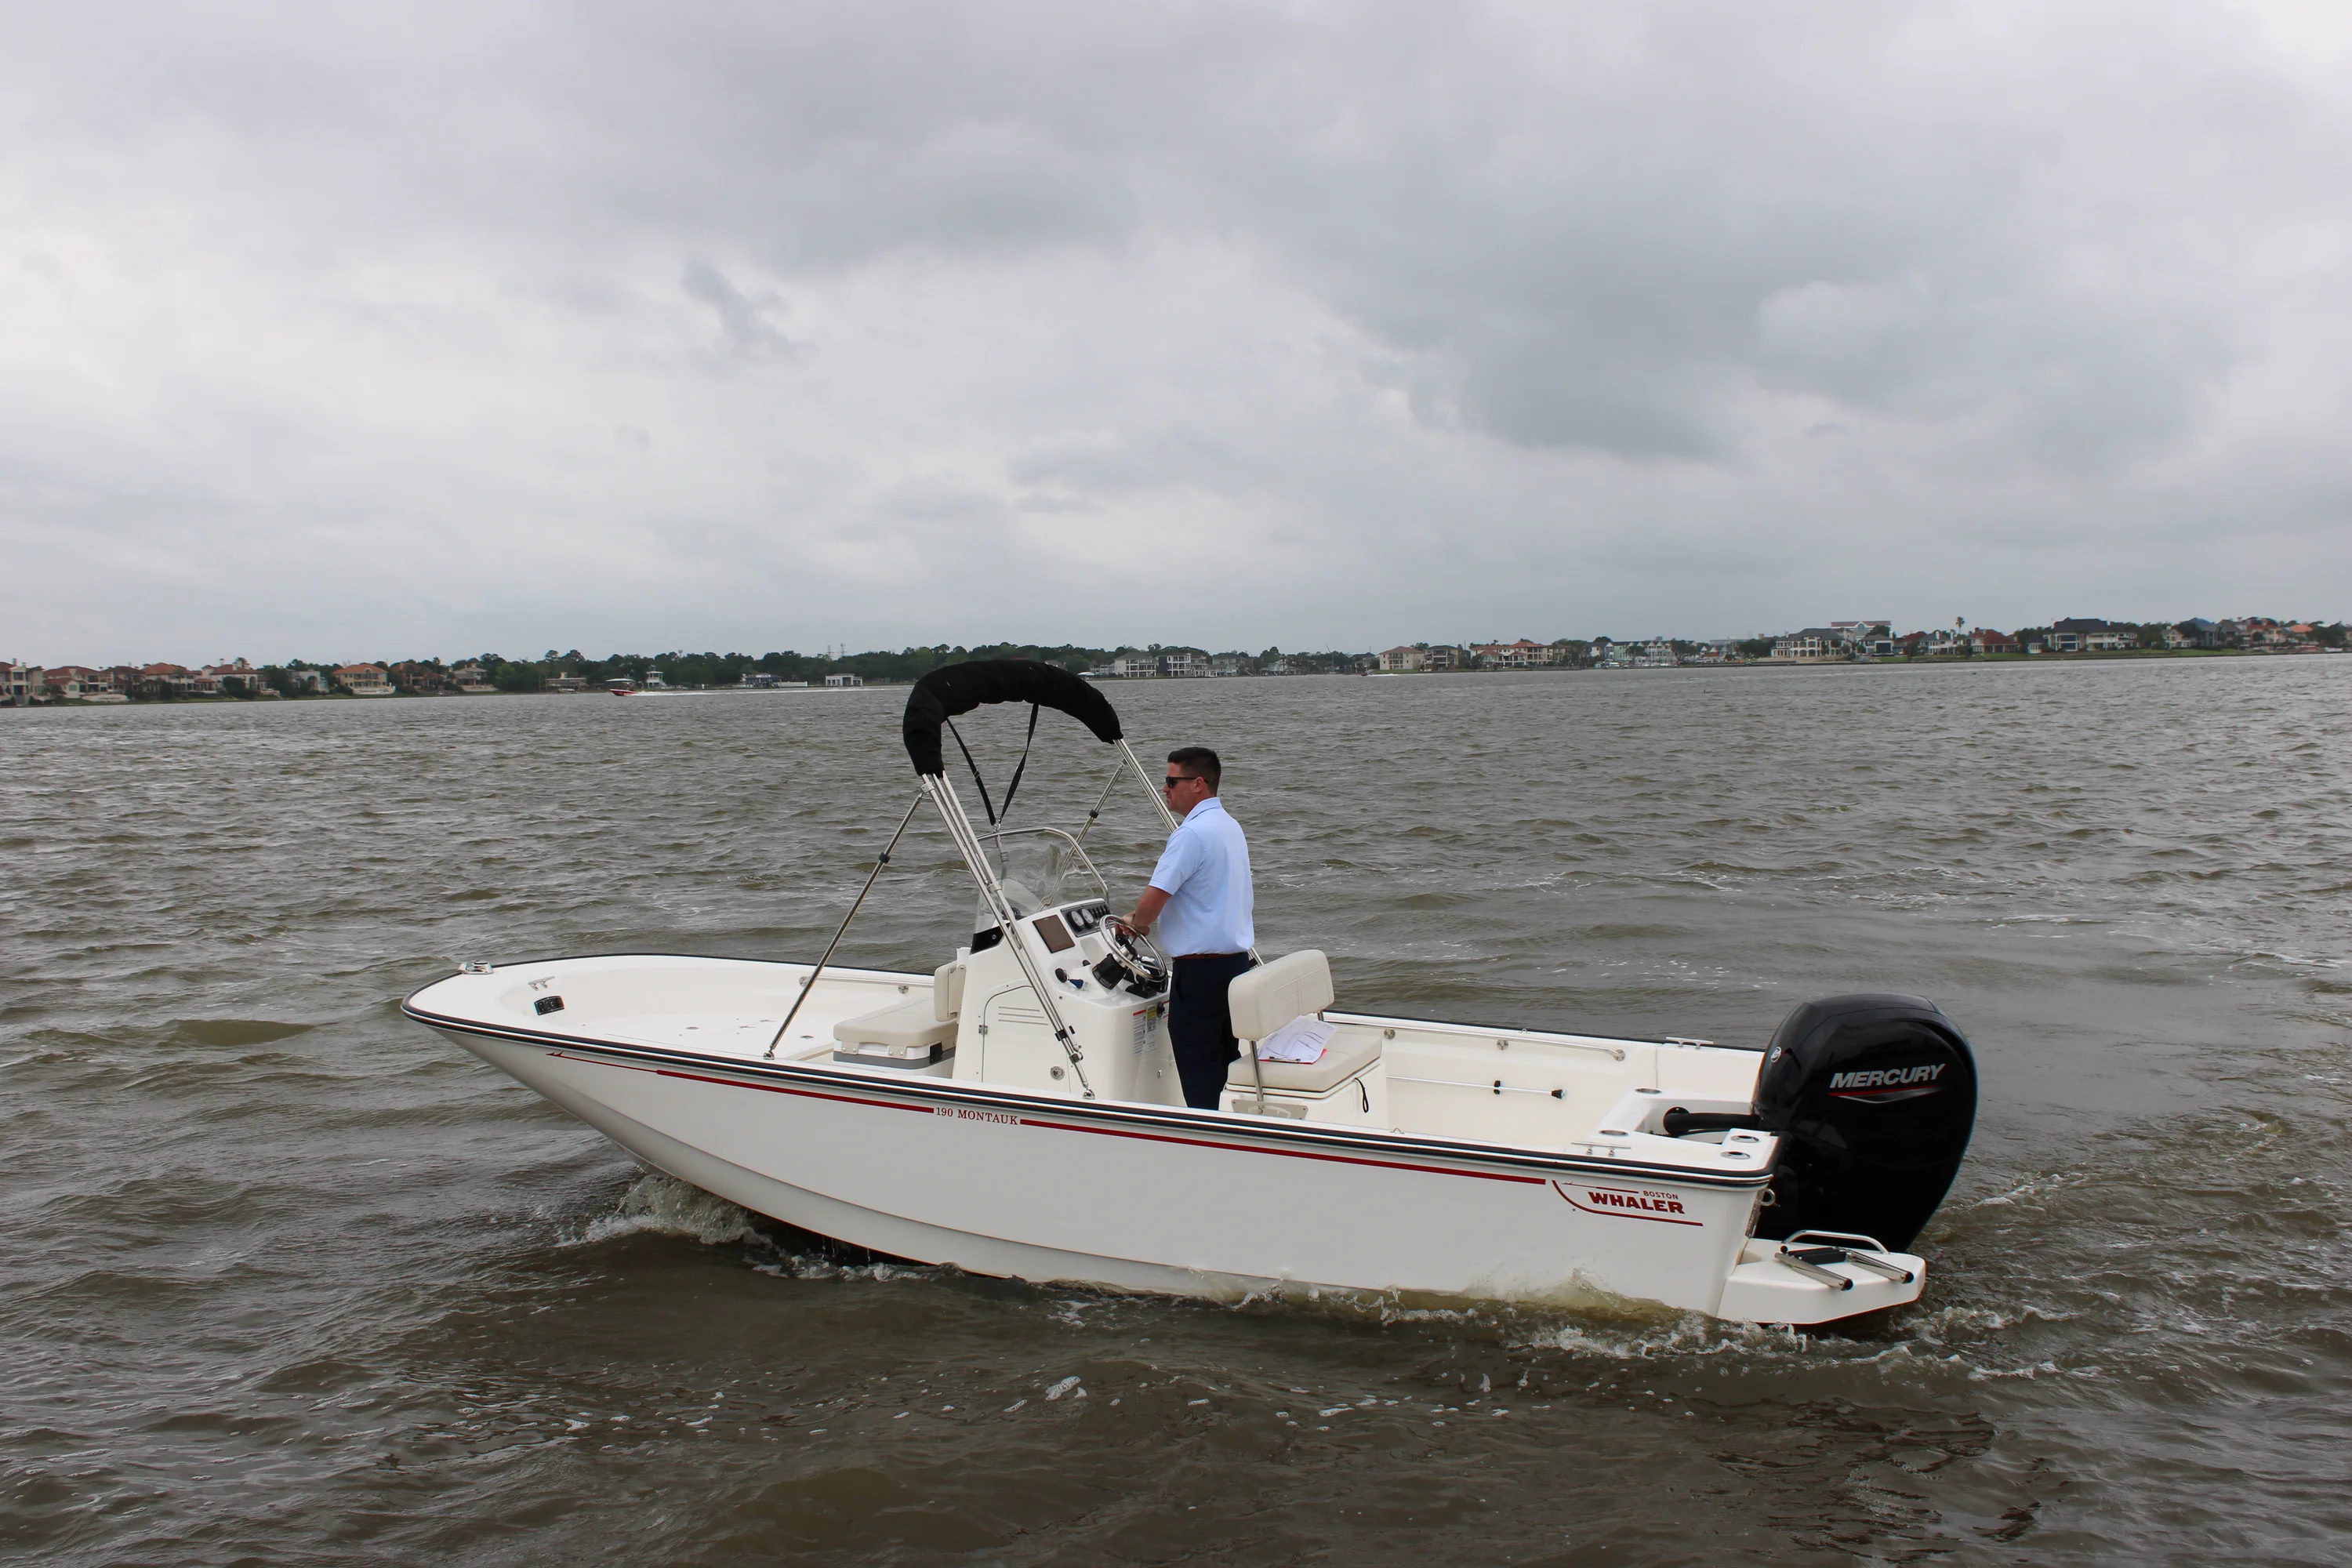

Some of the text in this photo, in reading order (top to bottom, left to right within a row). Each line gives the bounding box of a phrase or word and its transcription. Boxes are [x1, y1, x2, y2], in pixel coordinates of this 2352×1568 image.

[1829, 1063, 1946, 1088] MERCURY
[936, 1107, 1018, 1125] 190 MONTAUK
[1588, 1191, 1686, 1214] WHALER
[1642, 1190, 1679, 1200] BOSTON
